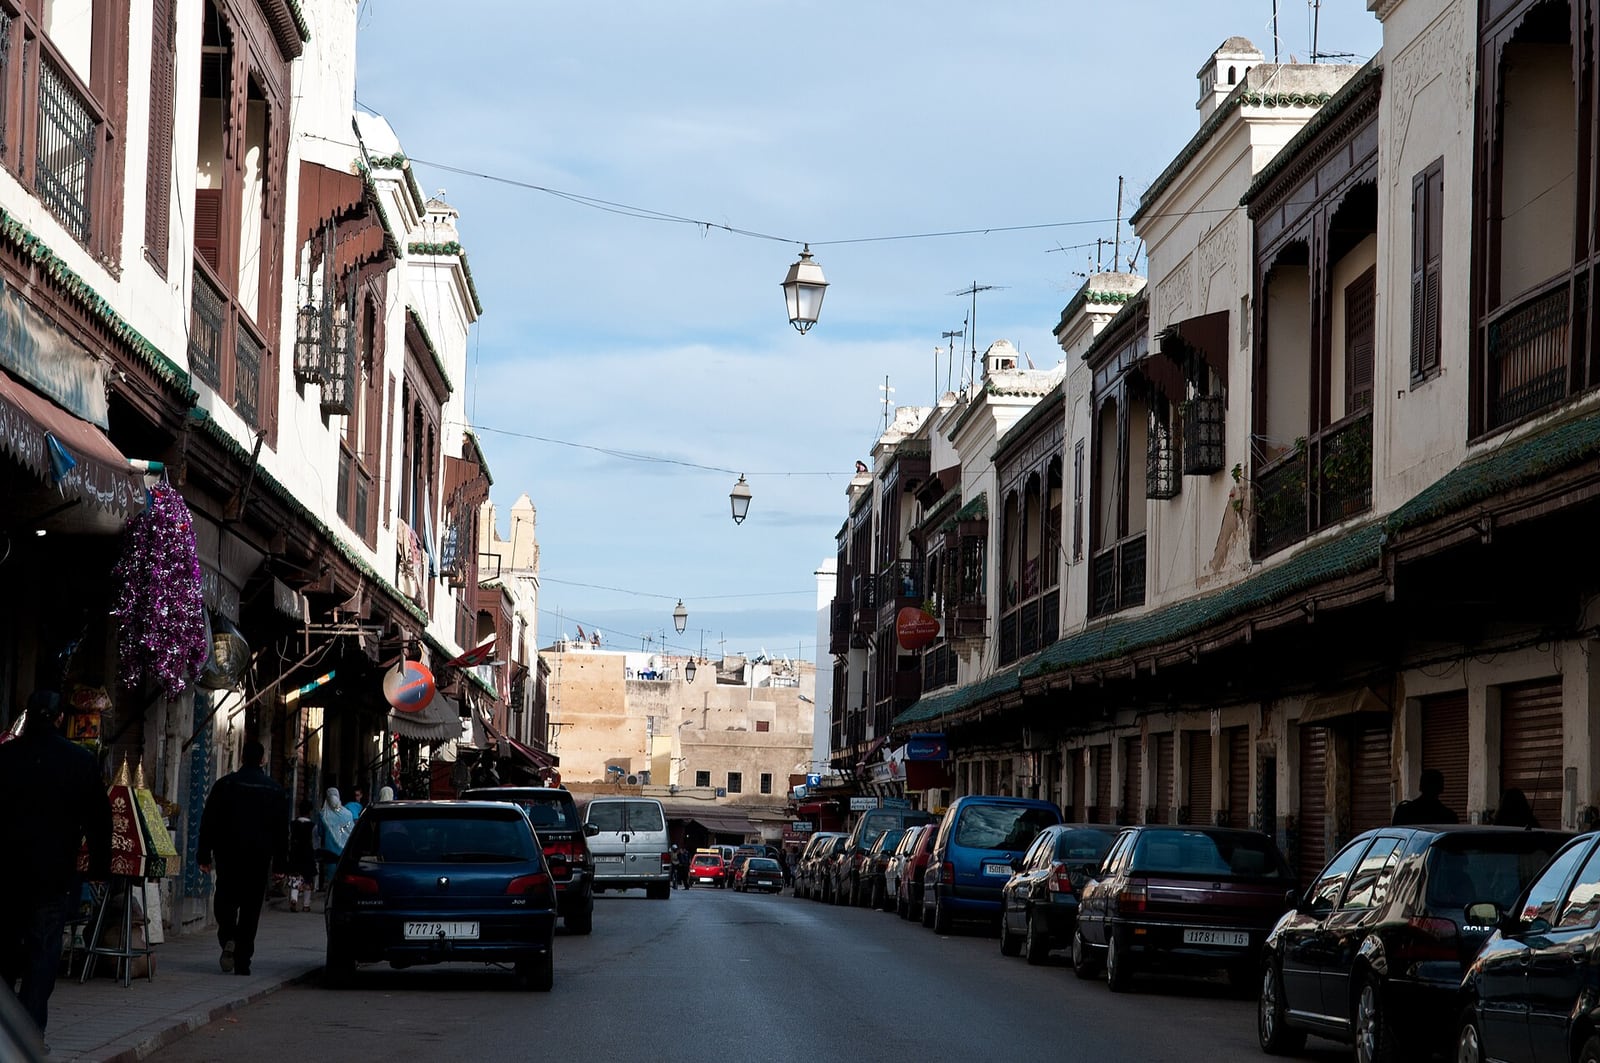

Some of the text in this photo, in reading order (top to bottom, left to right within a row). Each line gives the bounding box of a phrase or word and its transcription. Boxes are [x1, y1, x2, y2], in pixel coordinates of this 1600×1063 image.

[408, 923, 442, 936] 77712
[1190, 931, 1216, 942] 11781
[1233, 934, 1244, 945] 15
